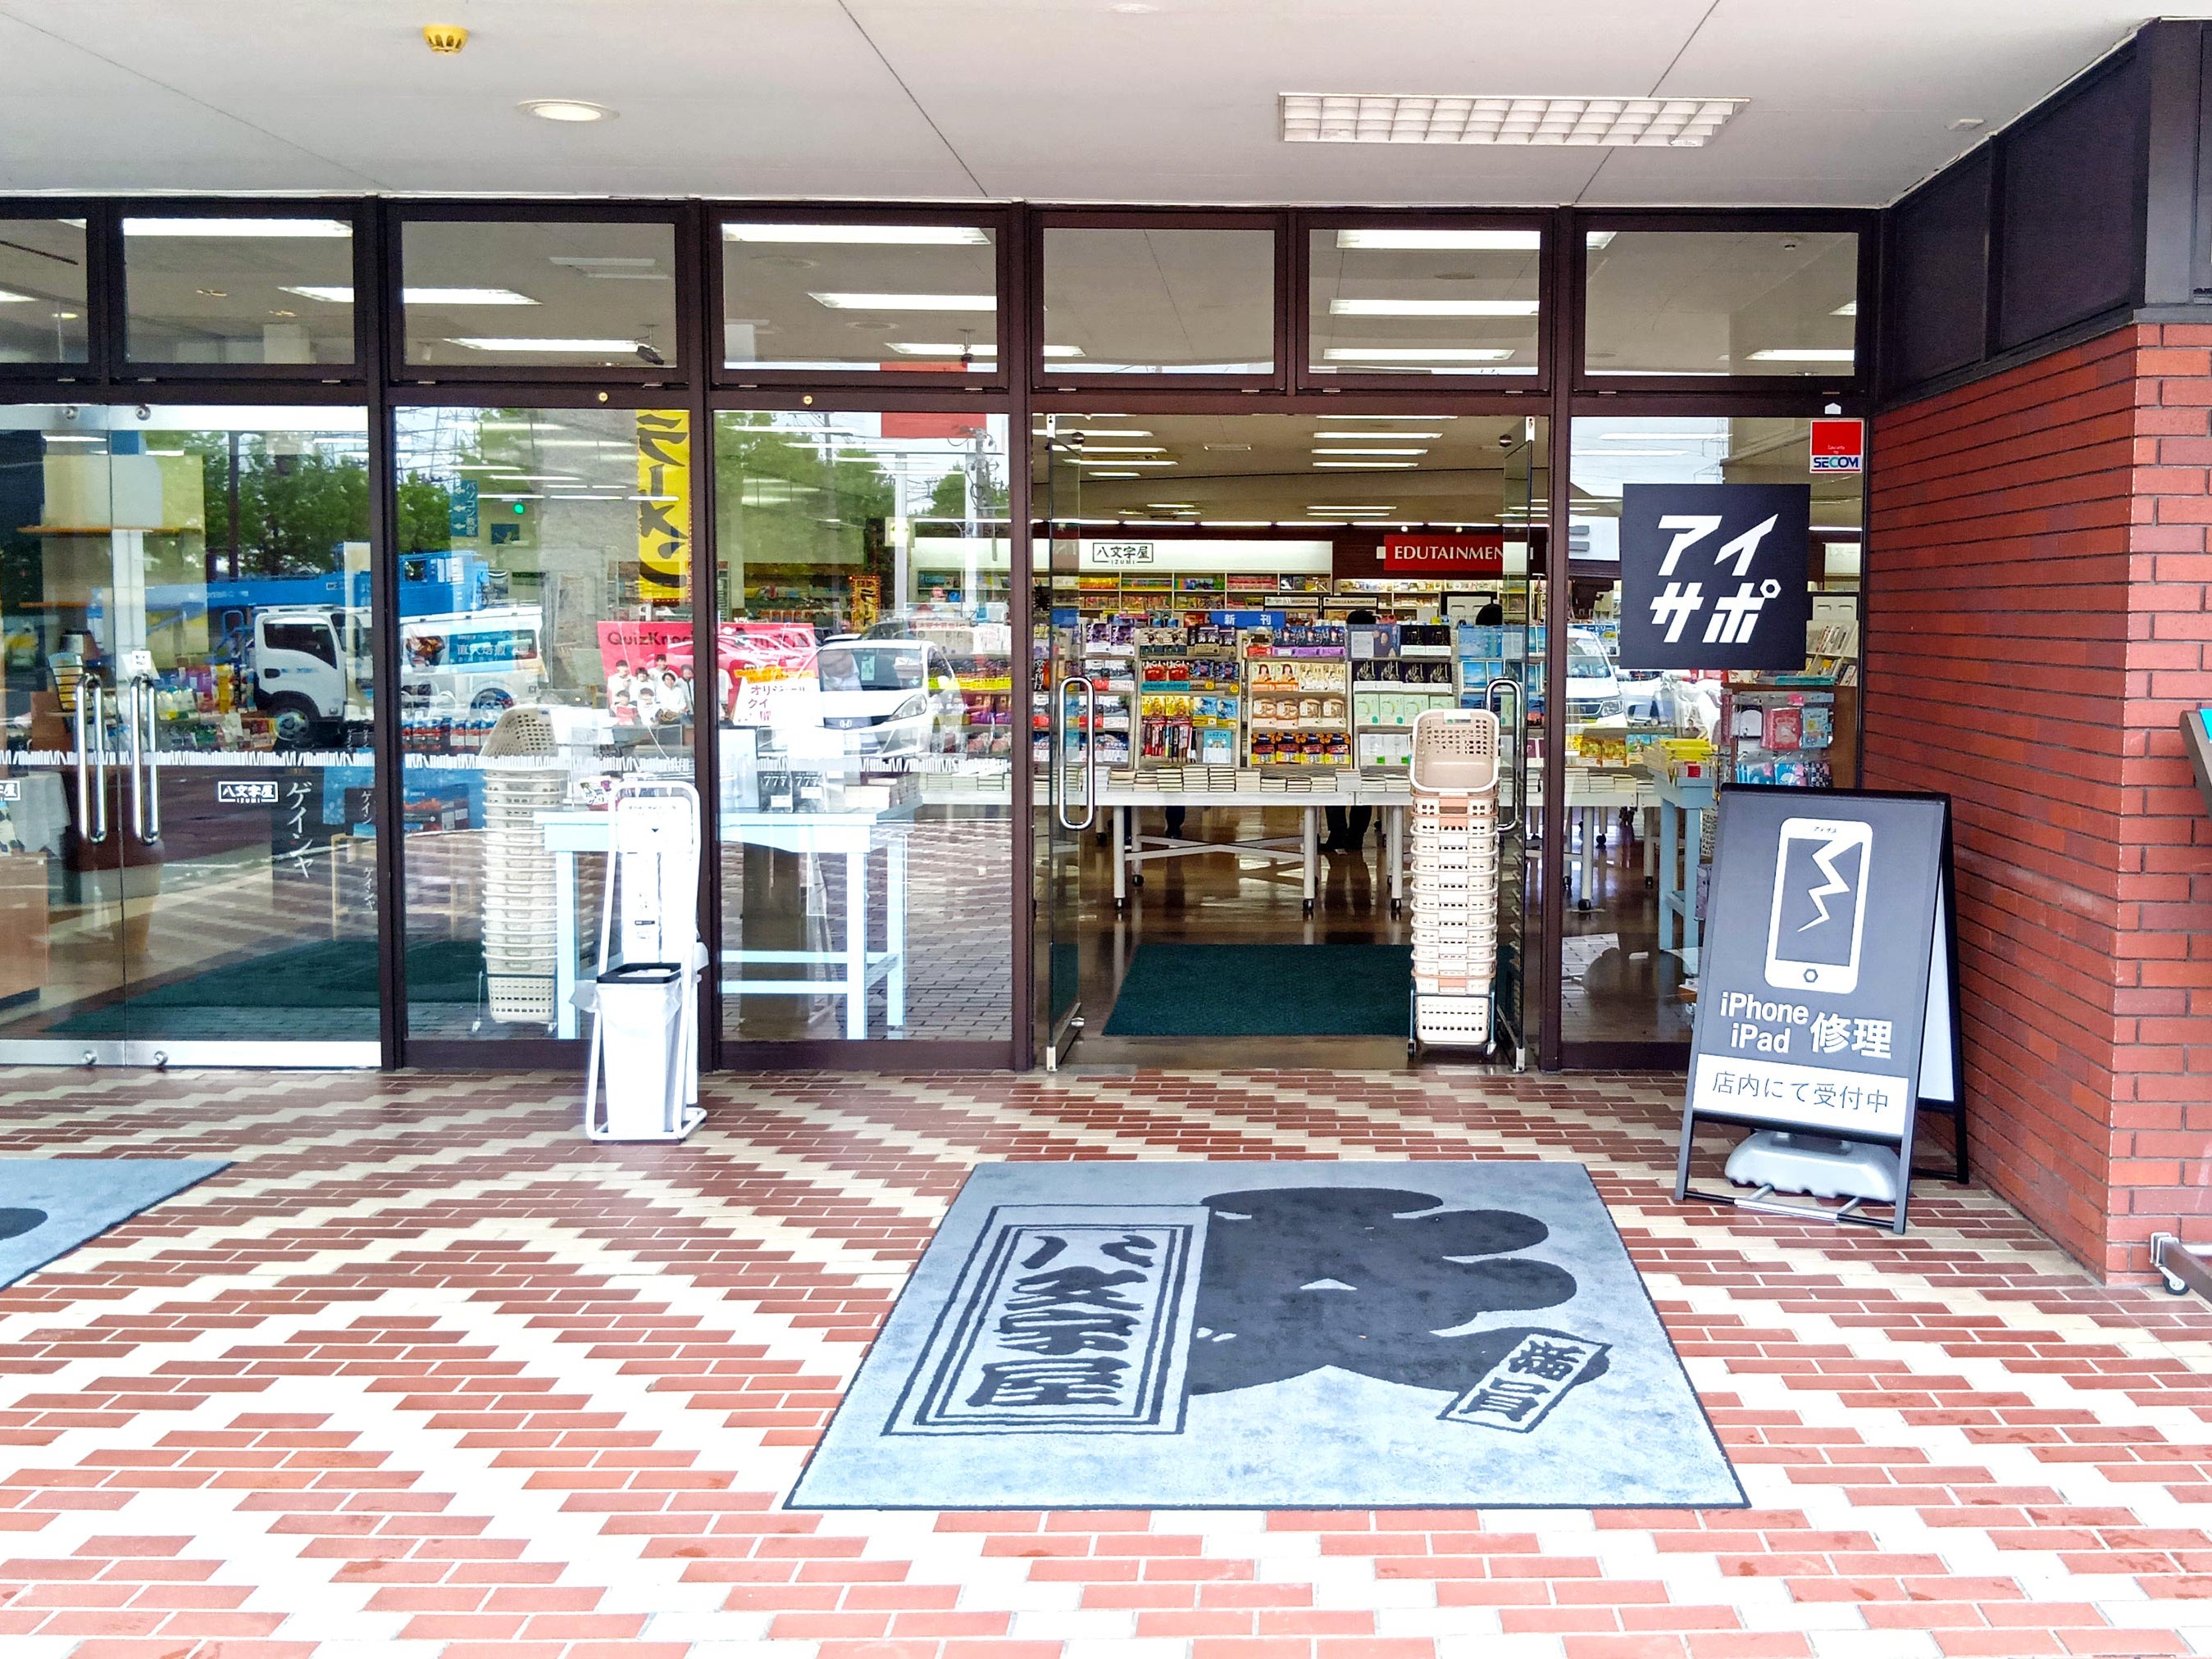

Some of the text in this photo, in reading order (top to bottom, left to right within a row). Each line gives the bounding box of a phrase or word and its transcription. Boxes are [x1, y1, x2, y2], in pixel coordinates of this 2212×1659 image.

[1813, 456, 1859, 468] SECOM
[1096, 545, 1150, 559] 八文字屋
[1394, 546, 1504, 561] EDUTAINMEN
[1657, 513, 1779, 576] アイ
[1649, 579, 1782, 643] サポ
[607, 630, 694, 646] QuizKnoc
[222, 784, 275, 798] 八文字屋
[1720, 991, 1809, 1025] iPhone
[1731, 1022, 1791, 1054] iPad
[1809, 1011, 1892, 1059] 修理
[1712, 1070, 1889, 1114] 店内にて受付中
